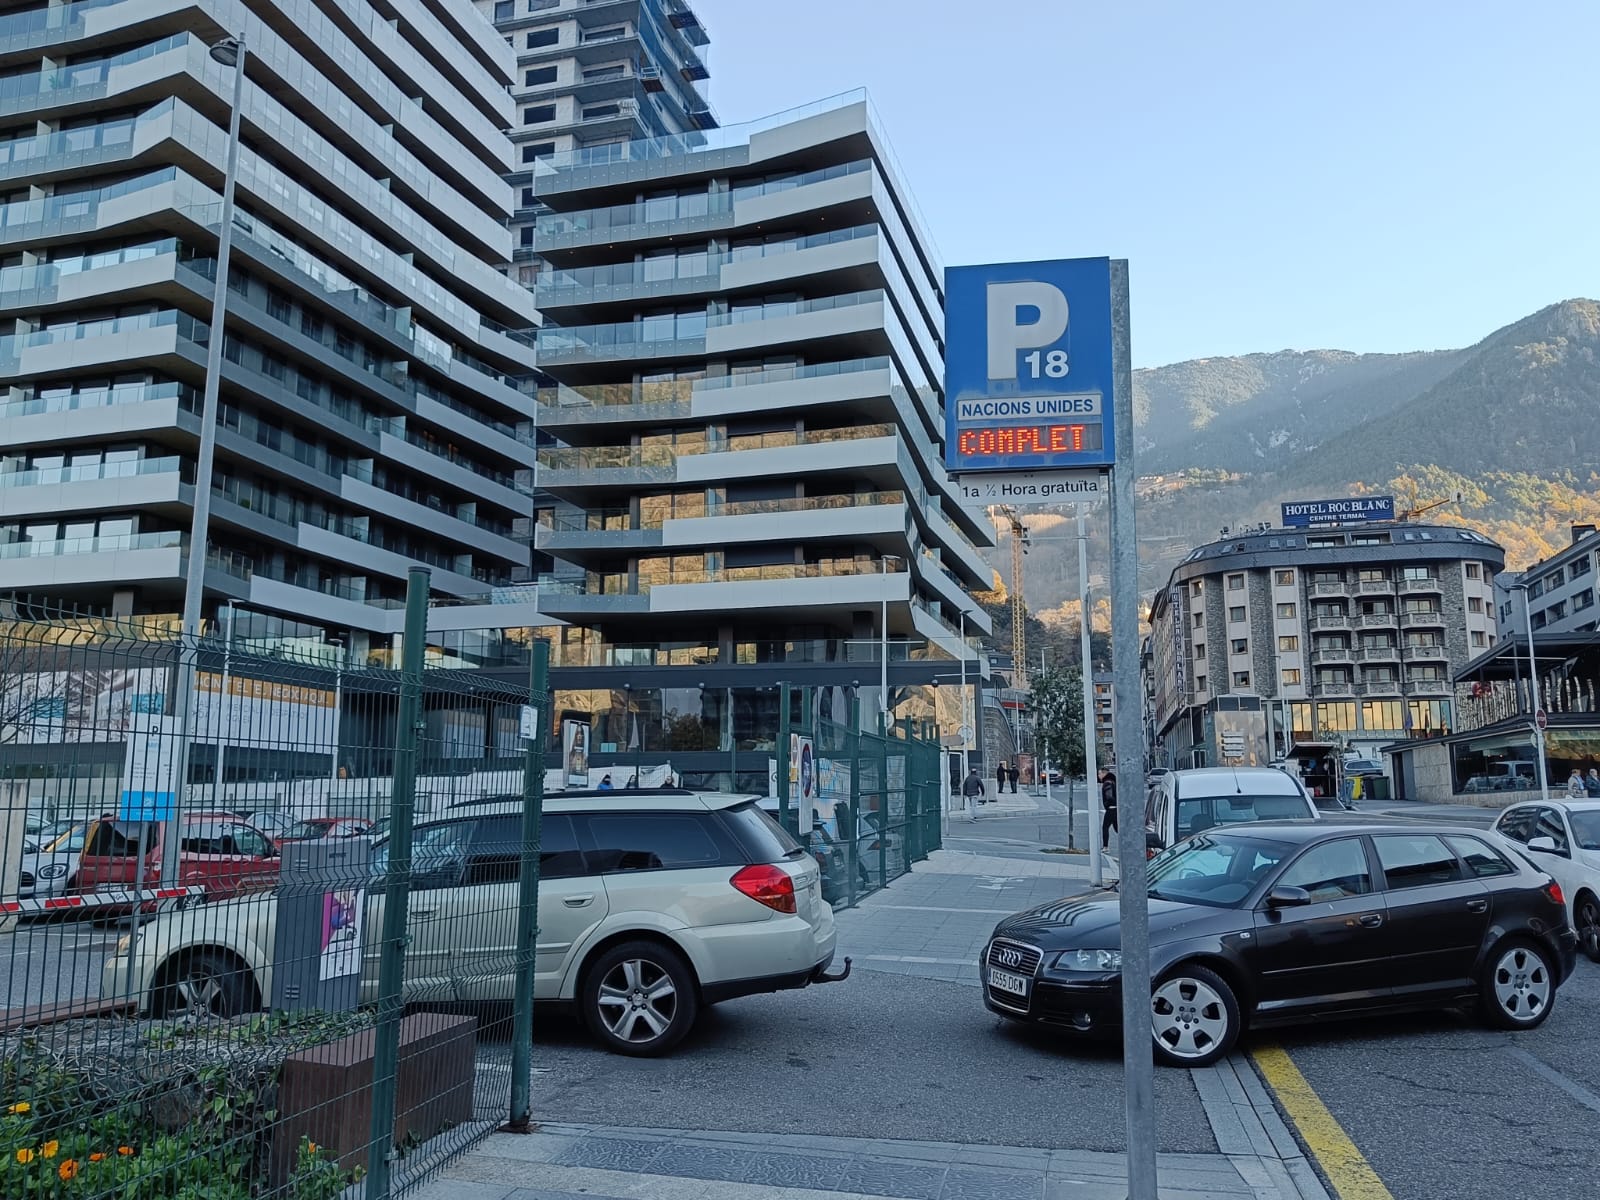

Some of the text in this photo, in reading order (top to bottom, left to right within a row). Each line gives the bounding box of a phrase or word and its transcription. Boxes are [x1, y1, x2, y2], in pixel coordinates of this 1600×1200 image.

[987, 281, 1069, 380] P
[1024, 350, 1069, 378] 18
[962, 399, 1093, 416] NACIONS UNIDES
[959, 425, 1084, 455] COMPLET
[962, 486, 979, 498] 1a
[1002, 482, 1037, 495] Hora
[1041, 480, 1098, 497] gratuïta
[1285, 504, 1326, 515] HOTEL
